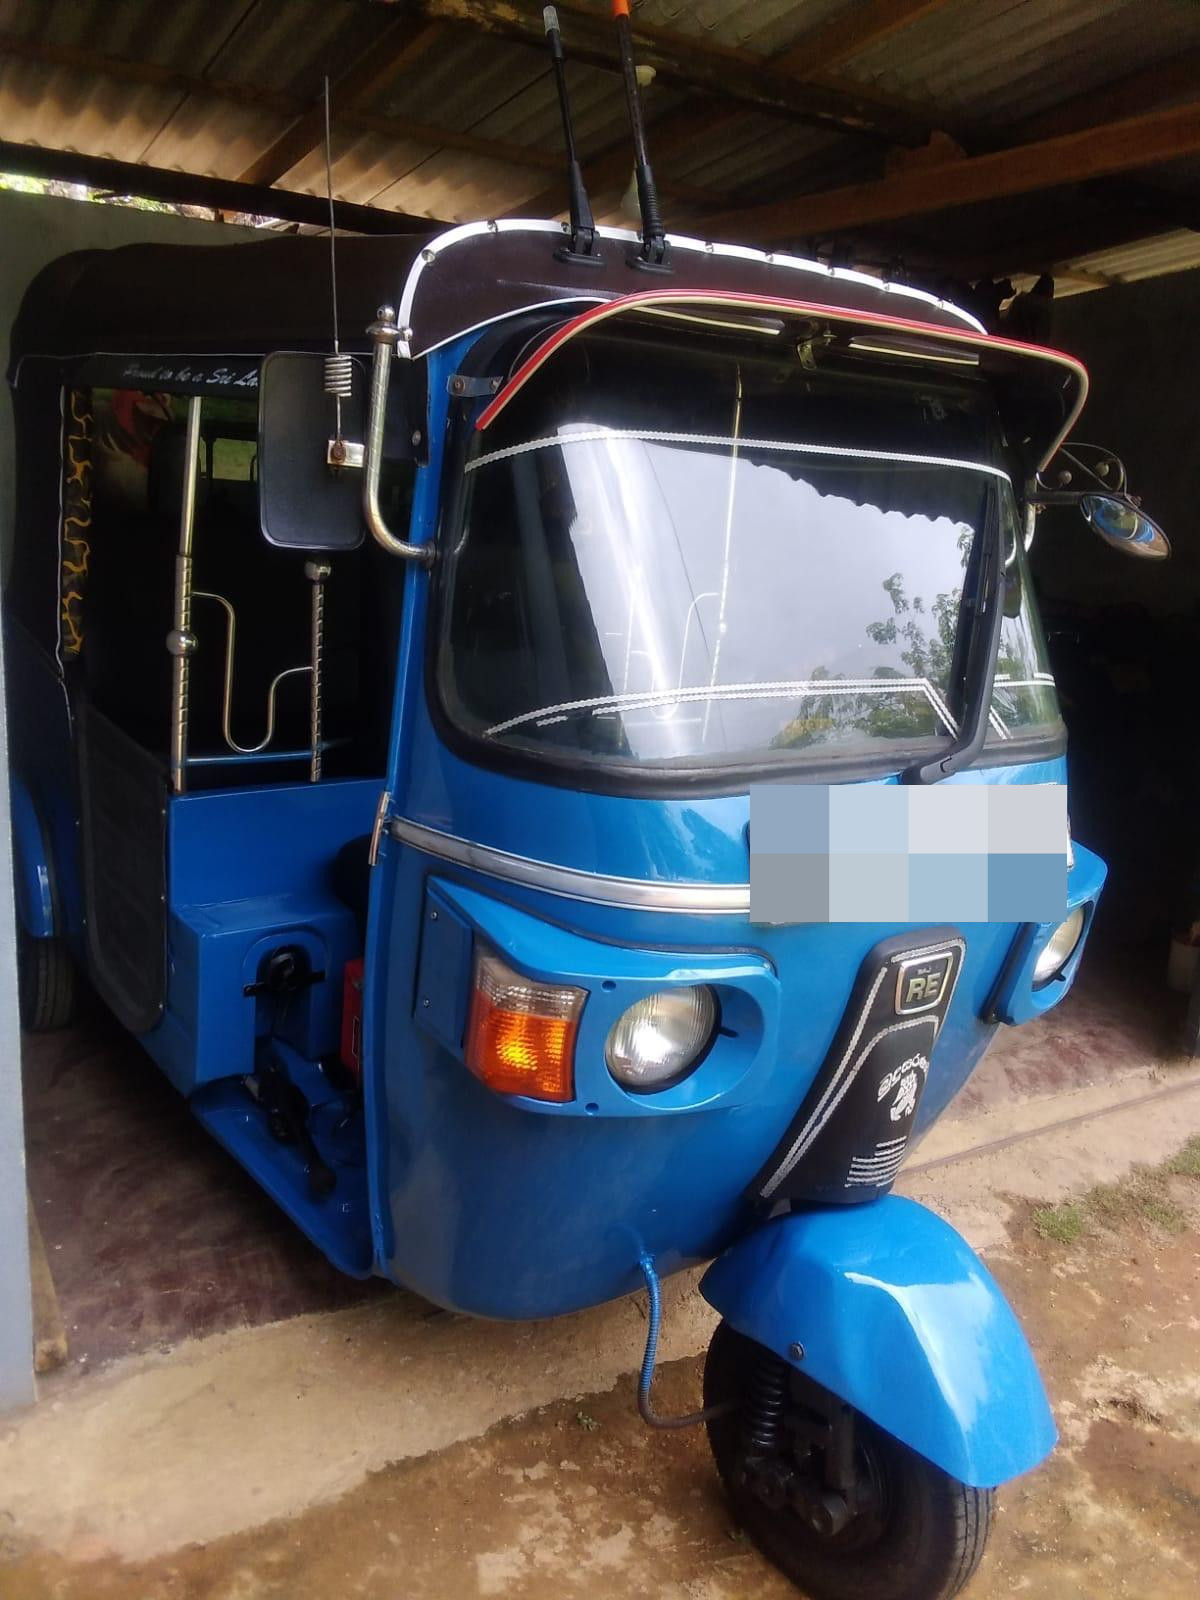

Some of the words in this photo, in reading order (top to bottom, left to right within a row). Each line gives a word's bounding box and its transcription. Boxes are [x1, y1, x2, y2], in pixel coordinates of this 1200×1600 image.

[206, 368, 236, 384] Sri
[233, 369, 259, 387] La
[906, 972, 941, 1003] RE
